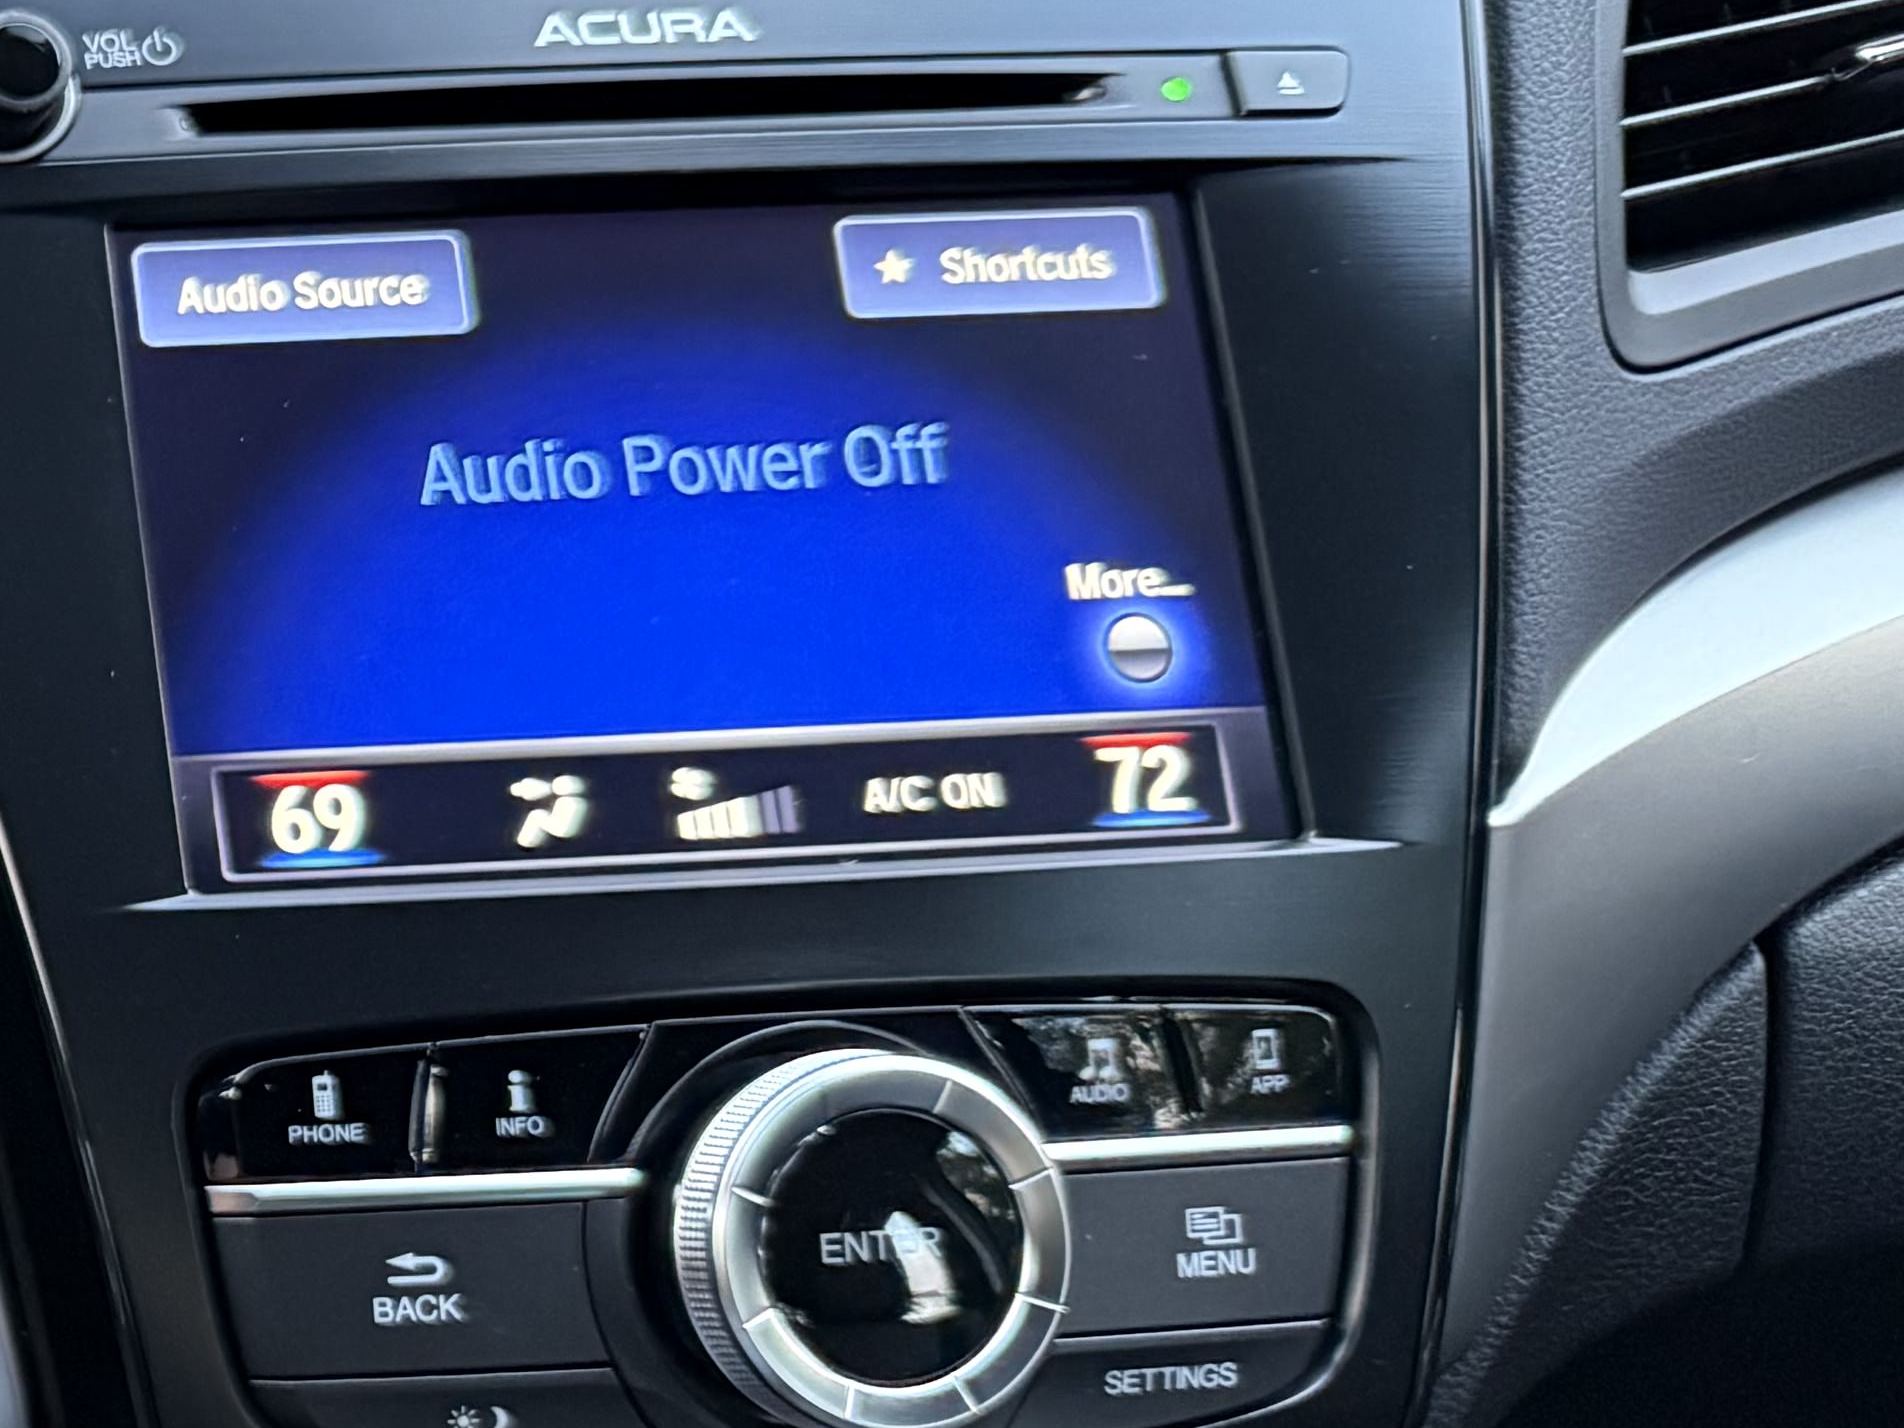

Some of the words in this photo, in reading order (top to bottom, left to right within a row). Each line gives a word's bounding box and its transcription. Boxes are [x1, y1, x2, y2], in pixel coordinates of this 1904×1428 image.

[81, 27, 142, 54] VOL
[532, 6, 764, 48] ACURA
[83, 51, 142, 71] PUSH
[938, 243, 1118, 285] Shortcuts
[175, 274, 291, 316] Audio
[292, 270, 431, 311] Source
[419, 437, 616, 507] Audio
[621, 432, 833, 498] Power
[843, 420, 950, 488] Off
[862, 775, 938, 815] A/C
[939, 771, 1010, 811] ON
[1093, 743, 1200, 815] 72
[270, 782, 369, 855] 69
[1069, 1081, 1130, 1105] AUDIO
[1250, 1073, 1292, 1094] APP
[287, 1122, 372, 1145] PHONE
[495, 1115, 554, 1138] INFO
[819, 1227, 947, 1267] ENTER
[1175, 1247, 1258, 1278] MENU
[372, 1292, 468, 1325] BACK
[1103, 1361, 1239, 1397] SETTINGS
